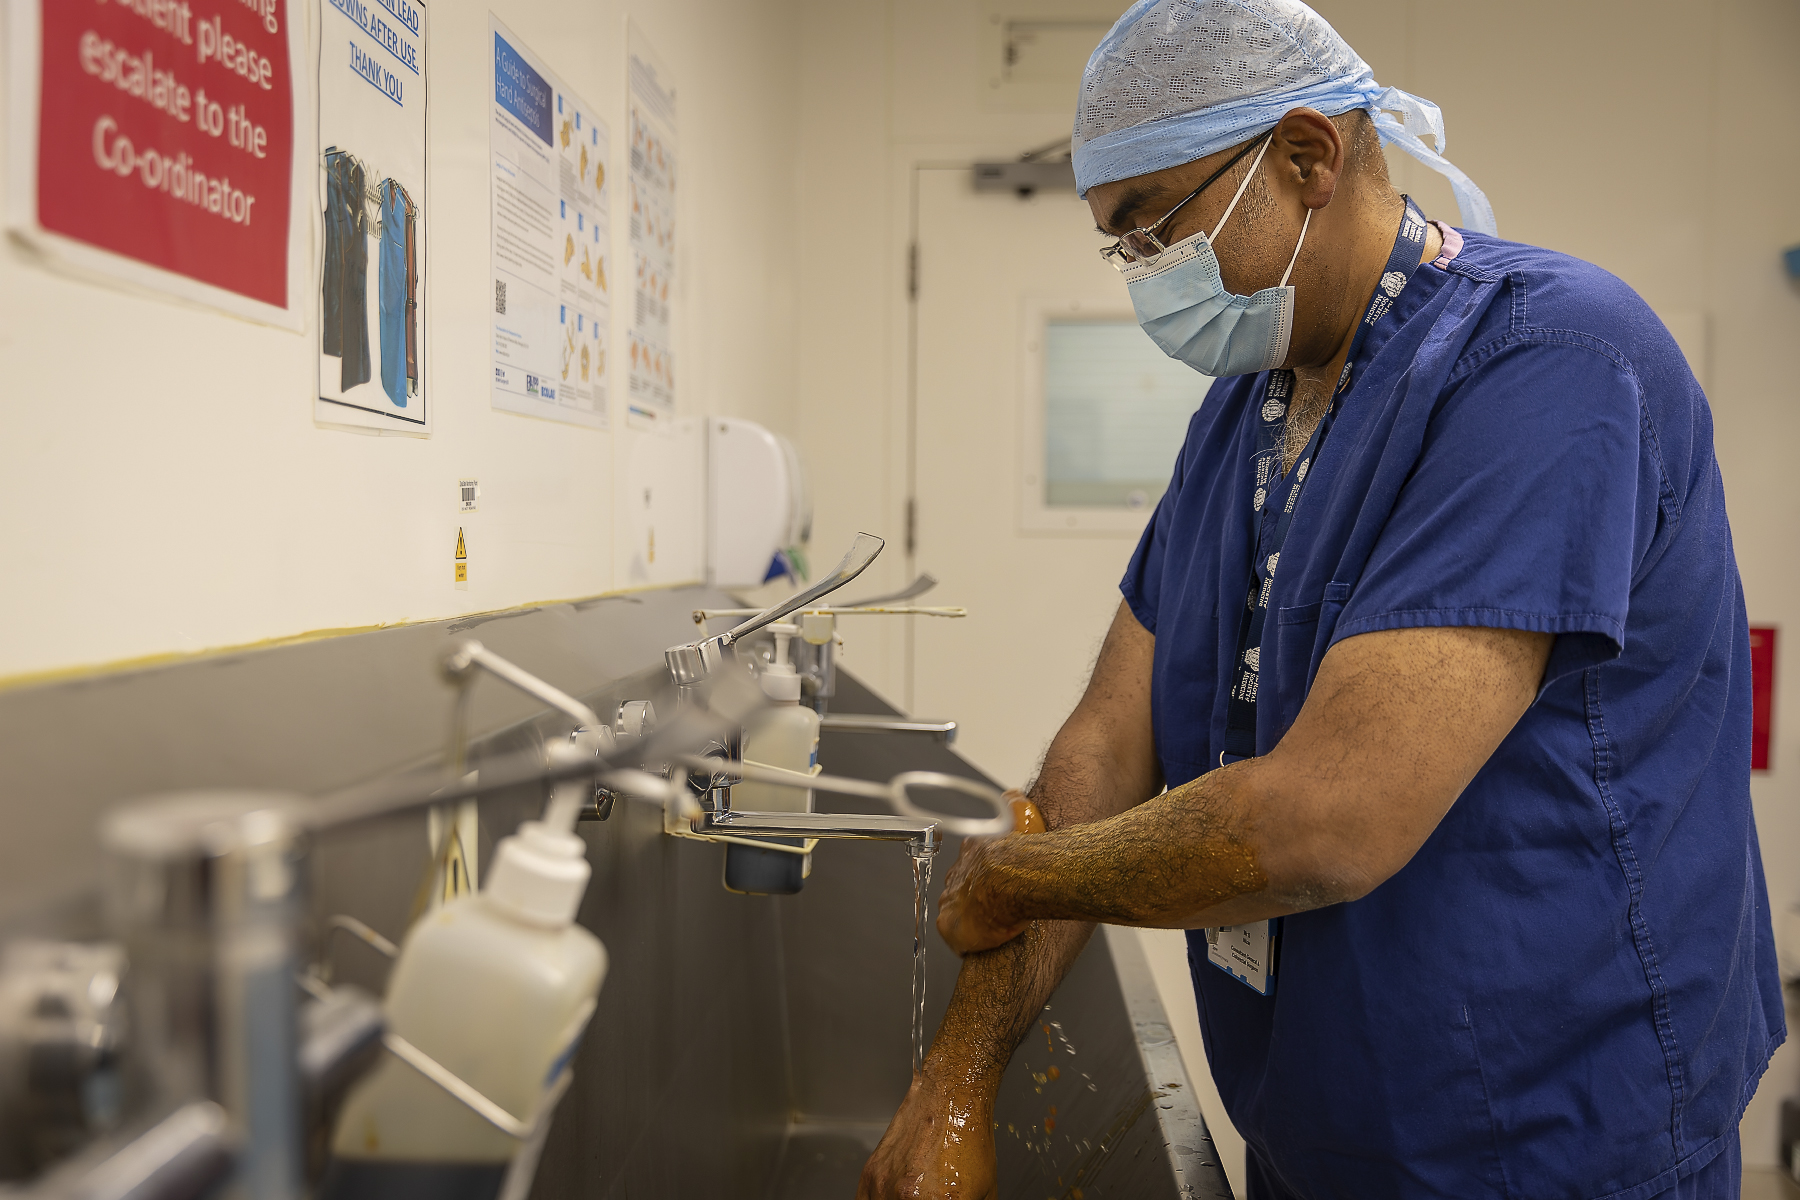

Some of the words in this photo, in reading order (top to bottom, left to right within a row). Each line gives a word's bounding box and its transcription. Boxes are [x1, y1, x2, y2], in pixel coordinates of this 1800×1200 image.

[332, 0, 368, 28] WNS
[371, 13, 398, 55] AFTER
[400, 37, 419, 71] USE.
[397, 0, 419, 31] LEAD
[197, 15, 272, 90] please
[350, 40, 382, 87] THANK
[383, 68, 403, 102] YOU
[496, 46, 501, 67] A
[501, 51, 519, 84] Guide
[519, 70, 526, 90] to
[78, 29, 191, 122] escalate
[194, 87, 225, 137] to
[227, 104, 267, 158] the
[496, 73, 513, 104] Hand
[91, 114, 256, 226] Co-ordinator
[1238, 670, 1250, 700] MEDICINE
